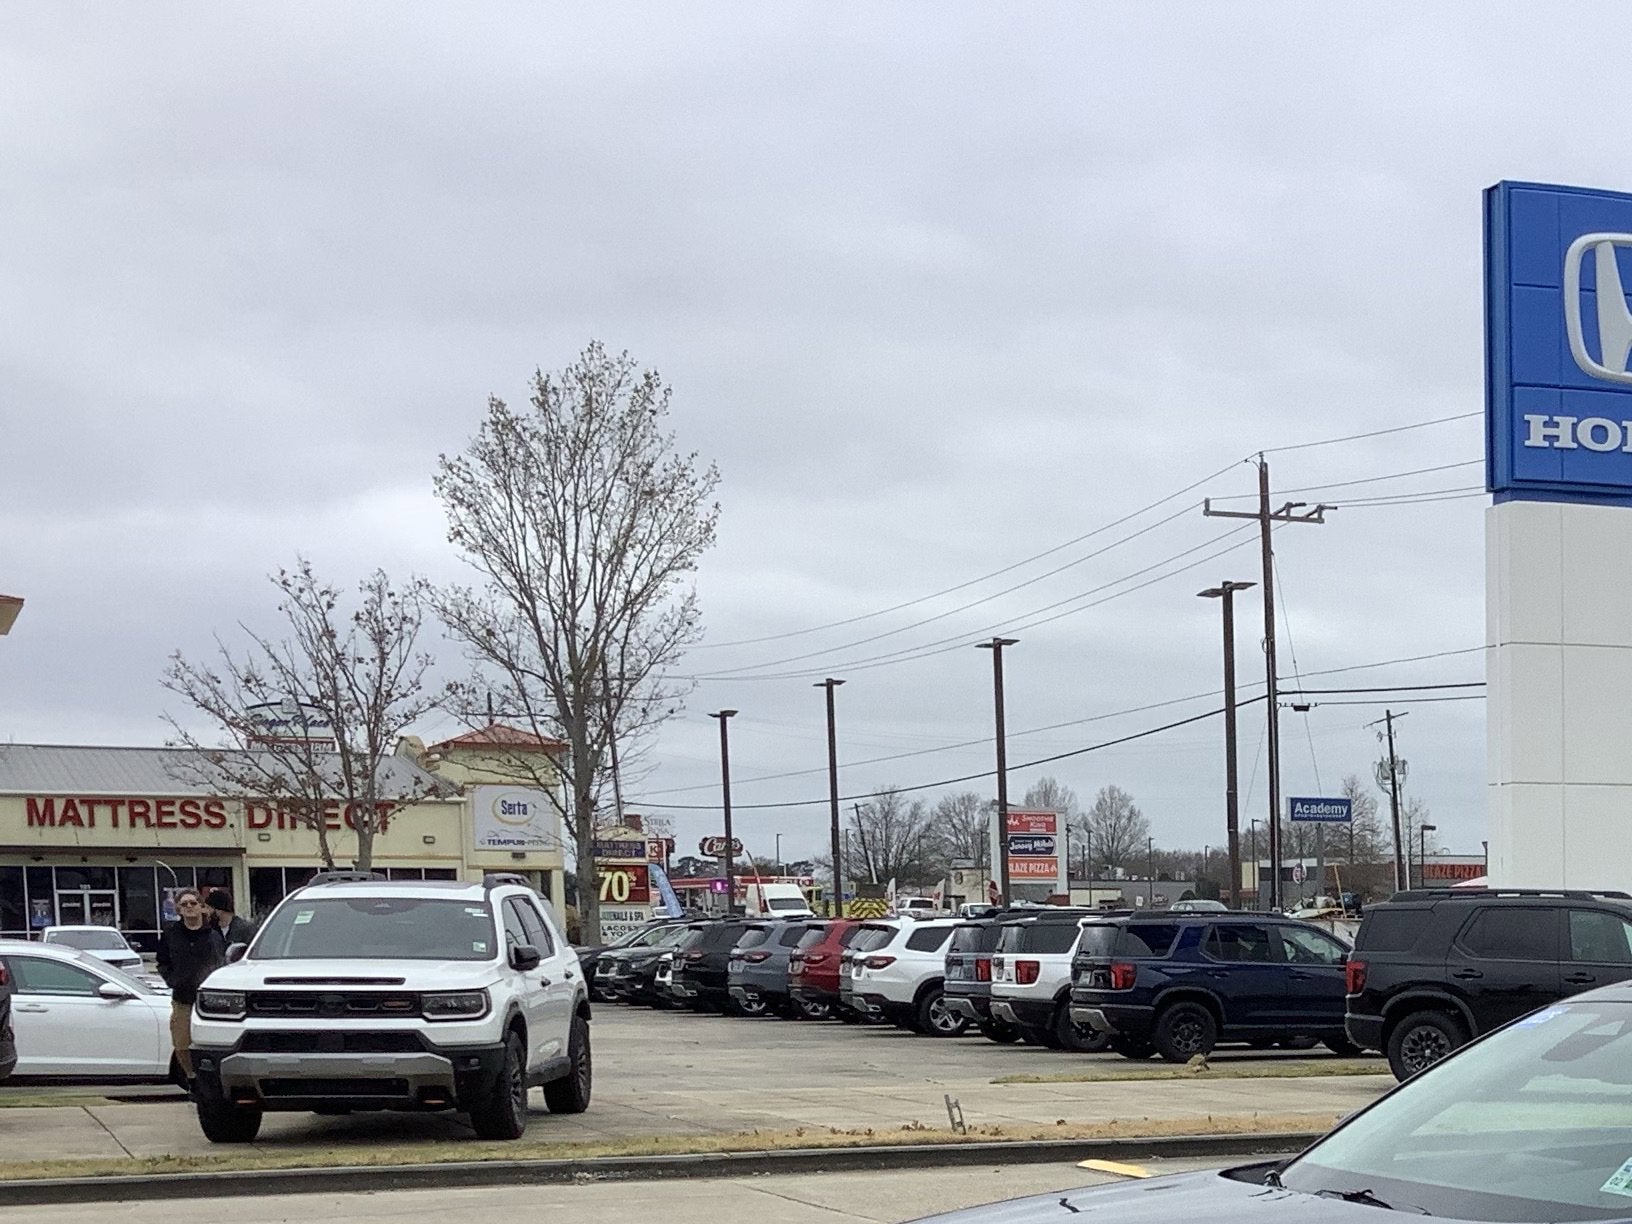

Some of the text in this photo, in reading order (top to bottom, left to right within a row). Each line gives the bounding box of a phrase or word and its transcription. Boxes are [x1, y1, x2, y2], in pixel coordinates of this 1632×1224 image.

[25, 798, 227, 829] MATTRESS
[501, 799, 528, 815] Serta
[1294, 801, 1348, 817] Academy
